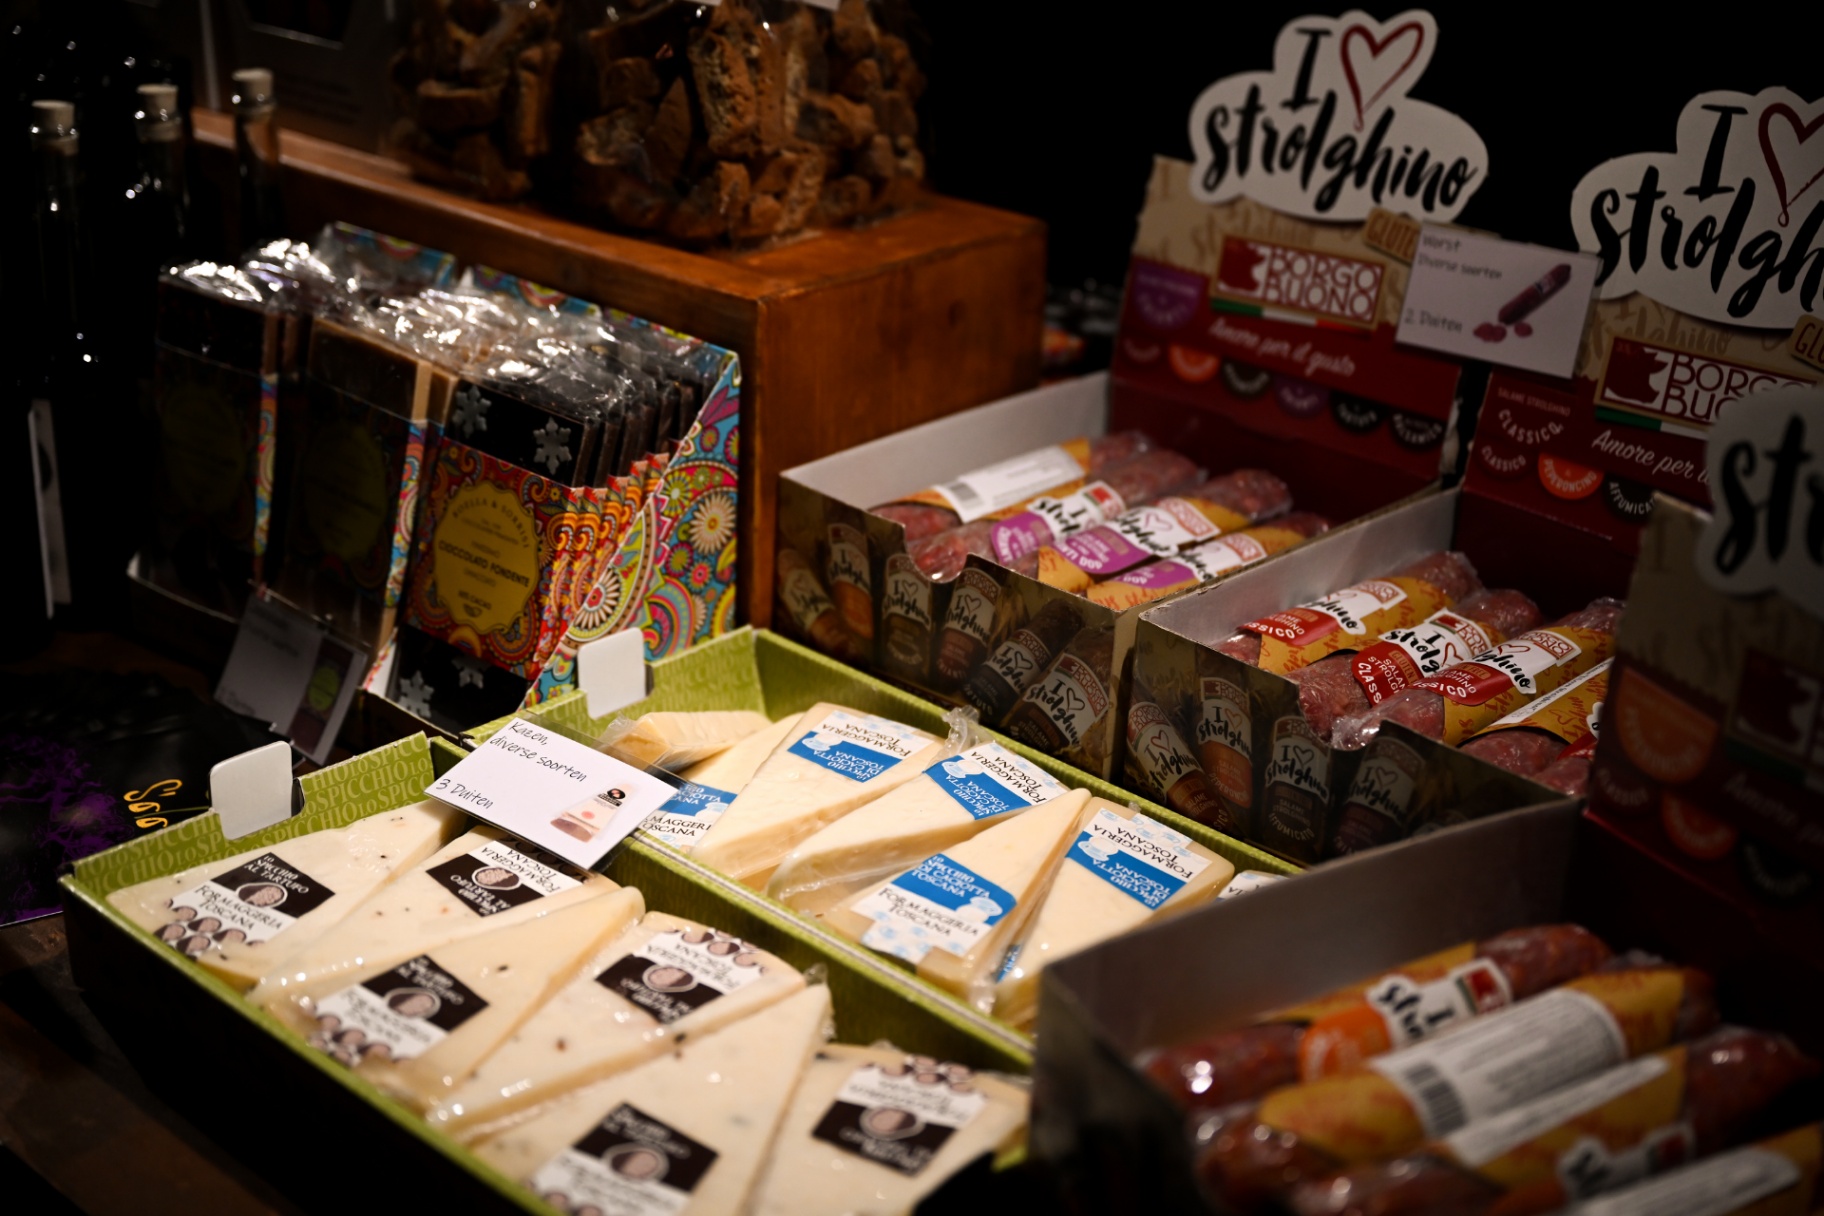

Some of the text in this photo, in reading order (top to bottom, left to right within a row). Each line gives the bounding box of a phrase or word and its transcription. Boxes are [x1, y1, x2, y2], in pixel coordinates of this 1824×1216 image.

[1279, 26, 1332, 112] I
[1684, 105, 1749, 203] I
[1267, 243, 1381, 293] BORGO
[1263, 276, 1374, 322] BUONO
[1591, 429, 1655, 466] Amore
[1652, 456, 1694, 479] per
[1606, 481, 1656, 515] AFFUMICAT
[822, 723, 912, 757] FORMAGGERIA
[845, 723, 900, 746] TOSCANA
[489, 735, 587, 782] diverse soorten
[813, 750, 865, 771] CACIOTTA
[834, 750, 885, 770] TOSCANA
[995, 756, 1042, 791] TOSCANA
[317, 760, 409, 812] SPICCHIO
[435, 778, 494, 810] 3 Duiten
[946, 775, 1002, 813] DI CACIOTTA
[970, 751, 1046, 804] FORMAGGERIA
[953, 789, 994, 815] SPICCHIO
[968, 780, 1009, 810] TOSCANA
[643, 823, 695, 836] OSCANA
[1116, 826, 1180, 863] TOSCANA
[507, 850, 556, 880] TOSCANA
[1093, 824, 1193, 879] FORMAGGERIA
[244, 865, 310, 894] AL TARTUFO
[255, 859, 298, 879] SPICCHIO
[480, 847, 561, 894] FORMAGGERIA
[912, 870, 965, 898] TOSCANA
[925, 859, 975, 883] SPICCHIO
[933, 868, 990, 898] CACIOTTA
[1092, 859, 1150, 891] CACIOTTA
[1115, 862, 1171, 893] TOSCANA
[1110, 875, 1162, 904] SPICCHIO
[194, 885, 284, 929] FORMAGGERIA
[199, 900, 255, 931] TOSCANA
[879, 888, 978, 936] FORMAGGERIA
[889, 903, 952, 936] TOSCANA
